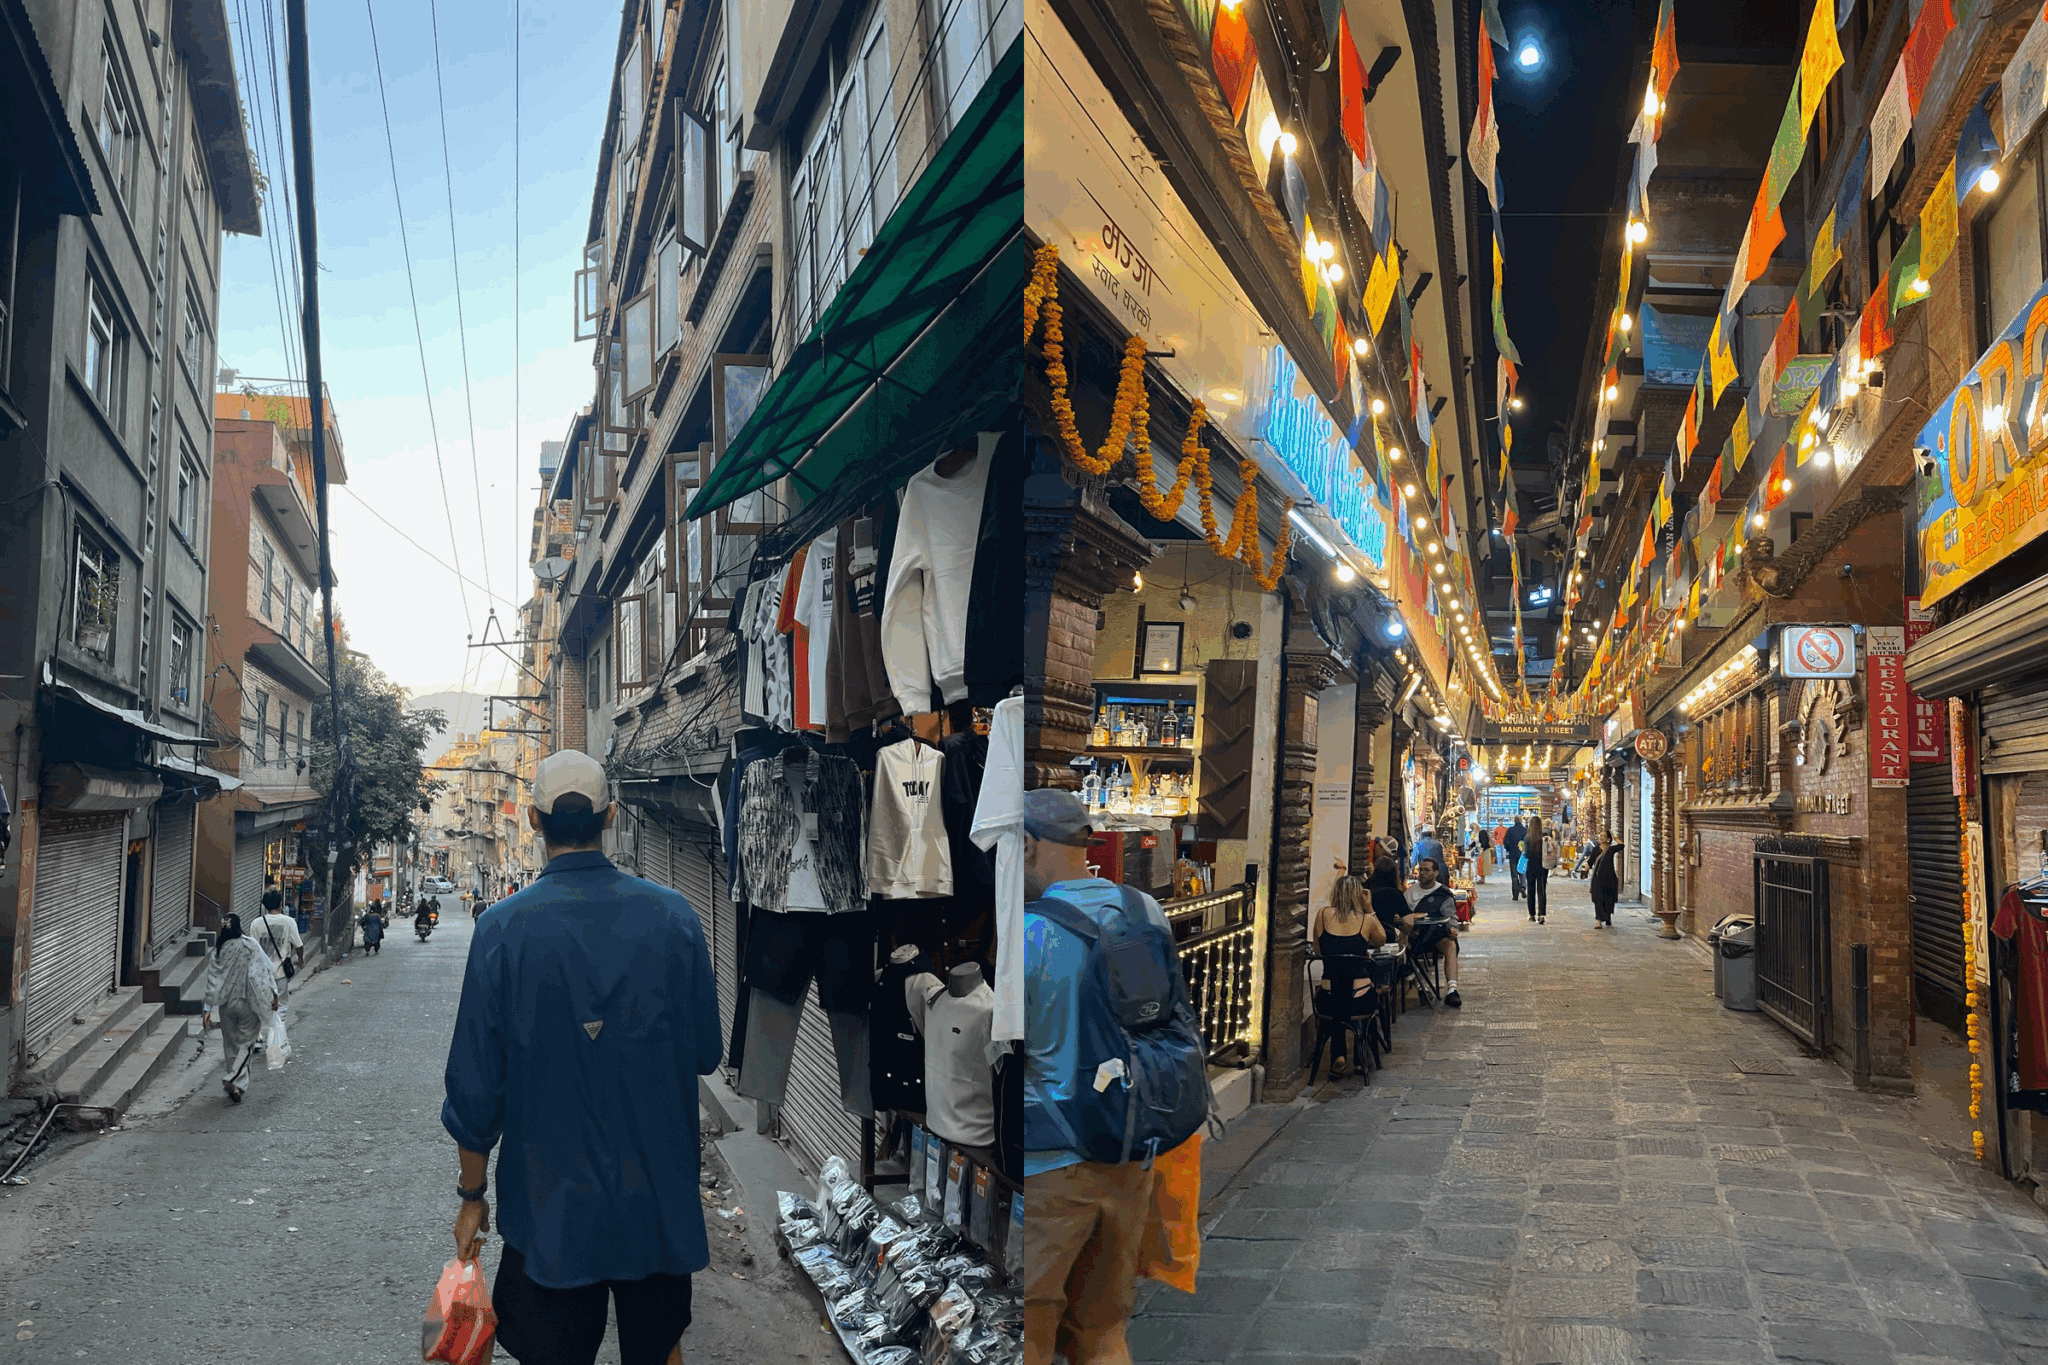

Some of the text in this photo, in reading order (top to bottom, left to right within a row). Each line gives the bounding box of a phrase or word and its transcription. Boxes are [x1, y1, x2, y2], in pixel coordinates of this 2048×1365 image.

[1500, 726, 1575, 735] MANDALA STREET
[1878, 656, 1901, 776] RESTAURANT
[1971, 834, 1984, 954] OR2K
